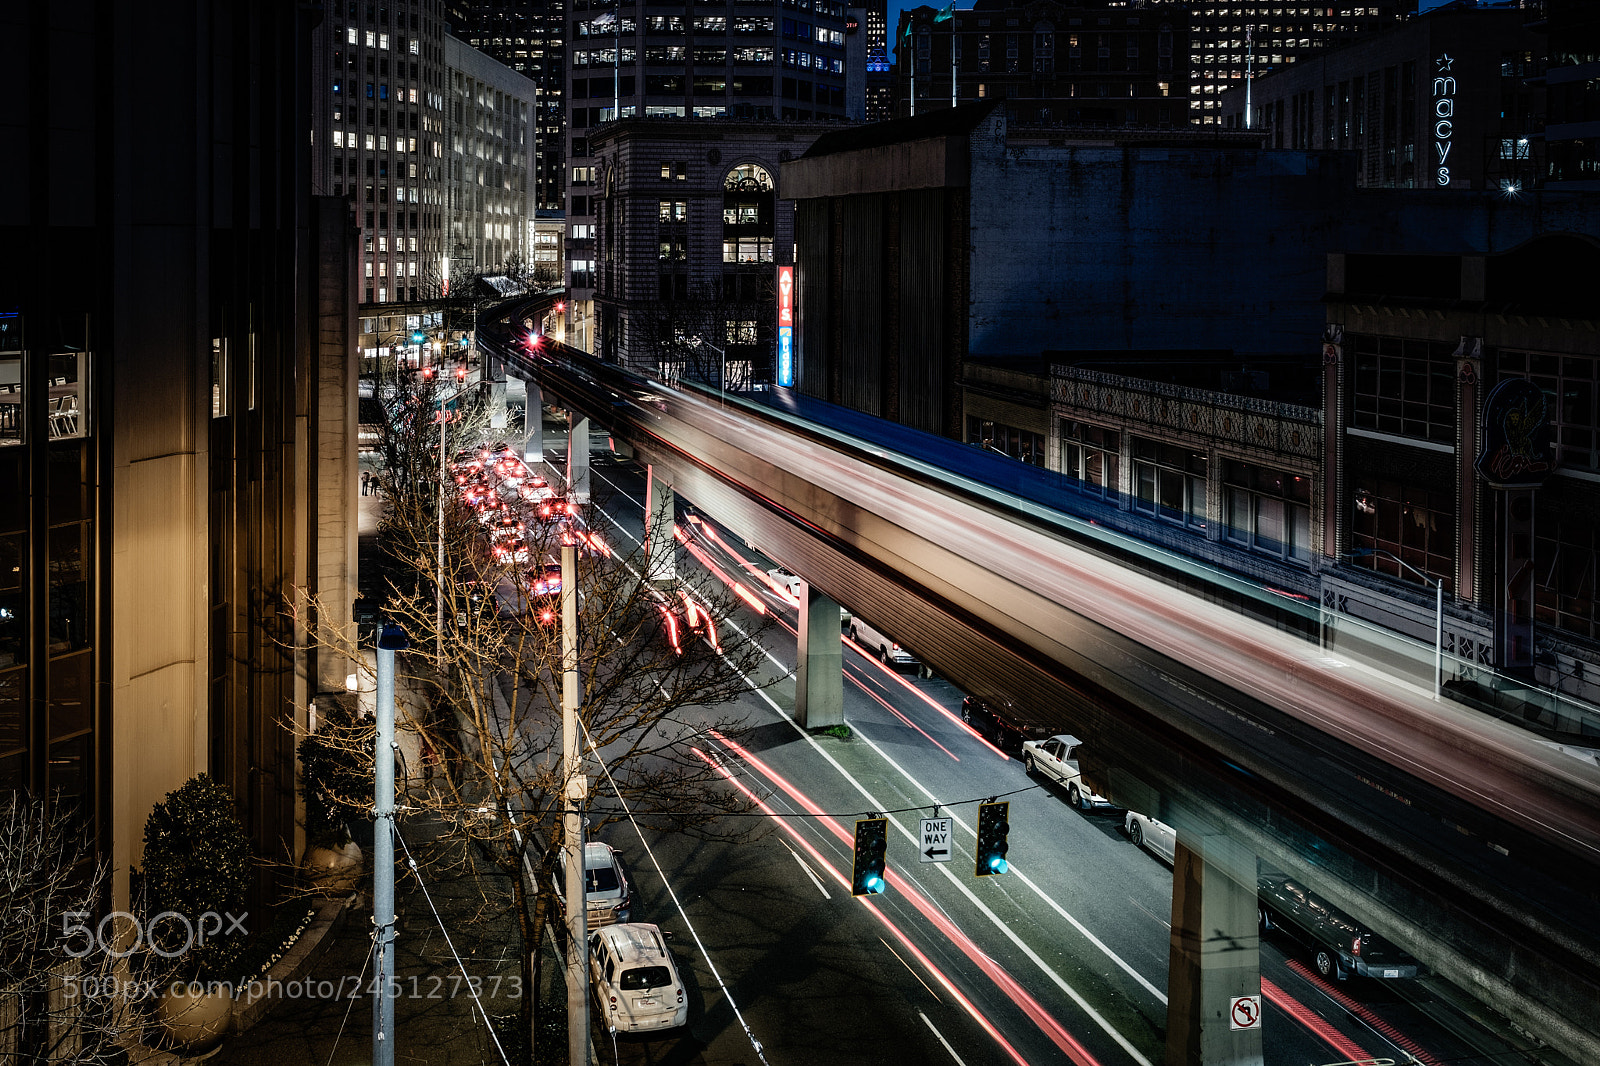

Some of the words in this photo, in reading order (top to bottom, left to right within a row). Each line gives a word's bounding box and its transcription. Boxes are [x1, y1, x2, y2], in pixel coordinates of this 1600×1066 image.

[1432, 76, 1456, 186] macys
[782, 336, 790, 384] Budget
[924, 833, 947, 845] WAY
[925, 821, 947, 832] ONE
